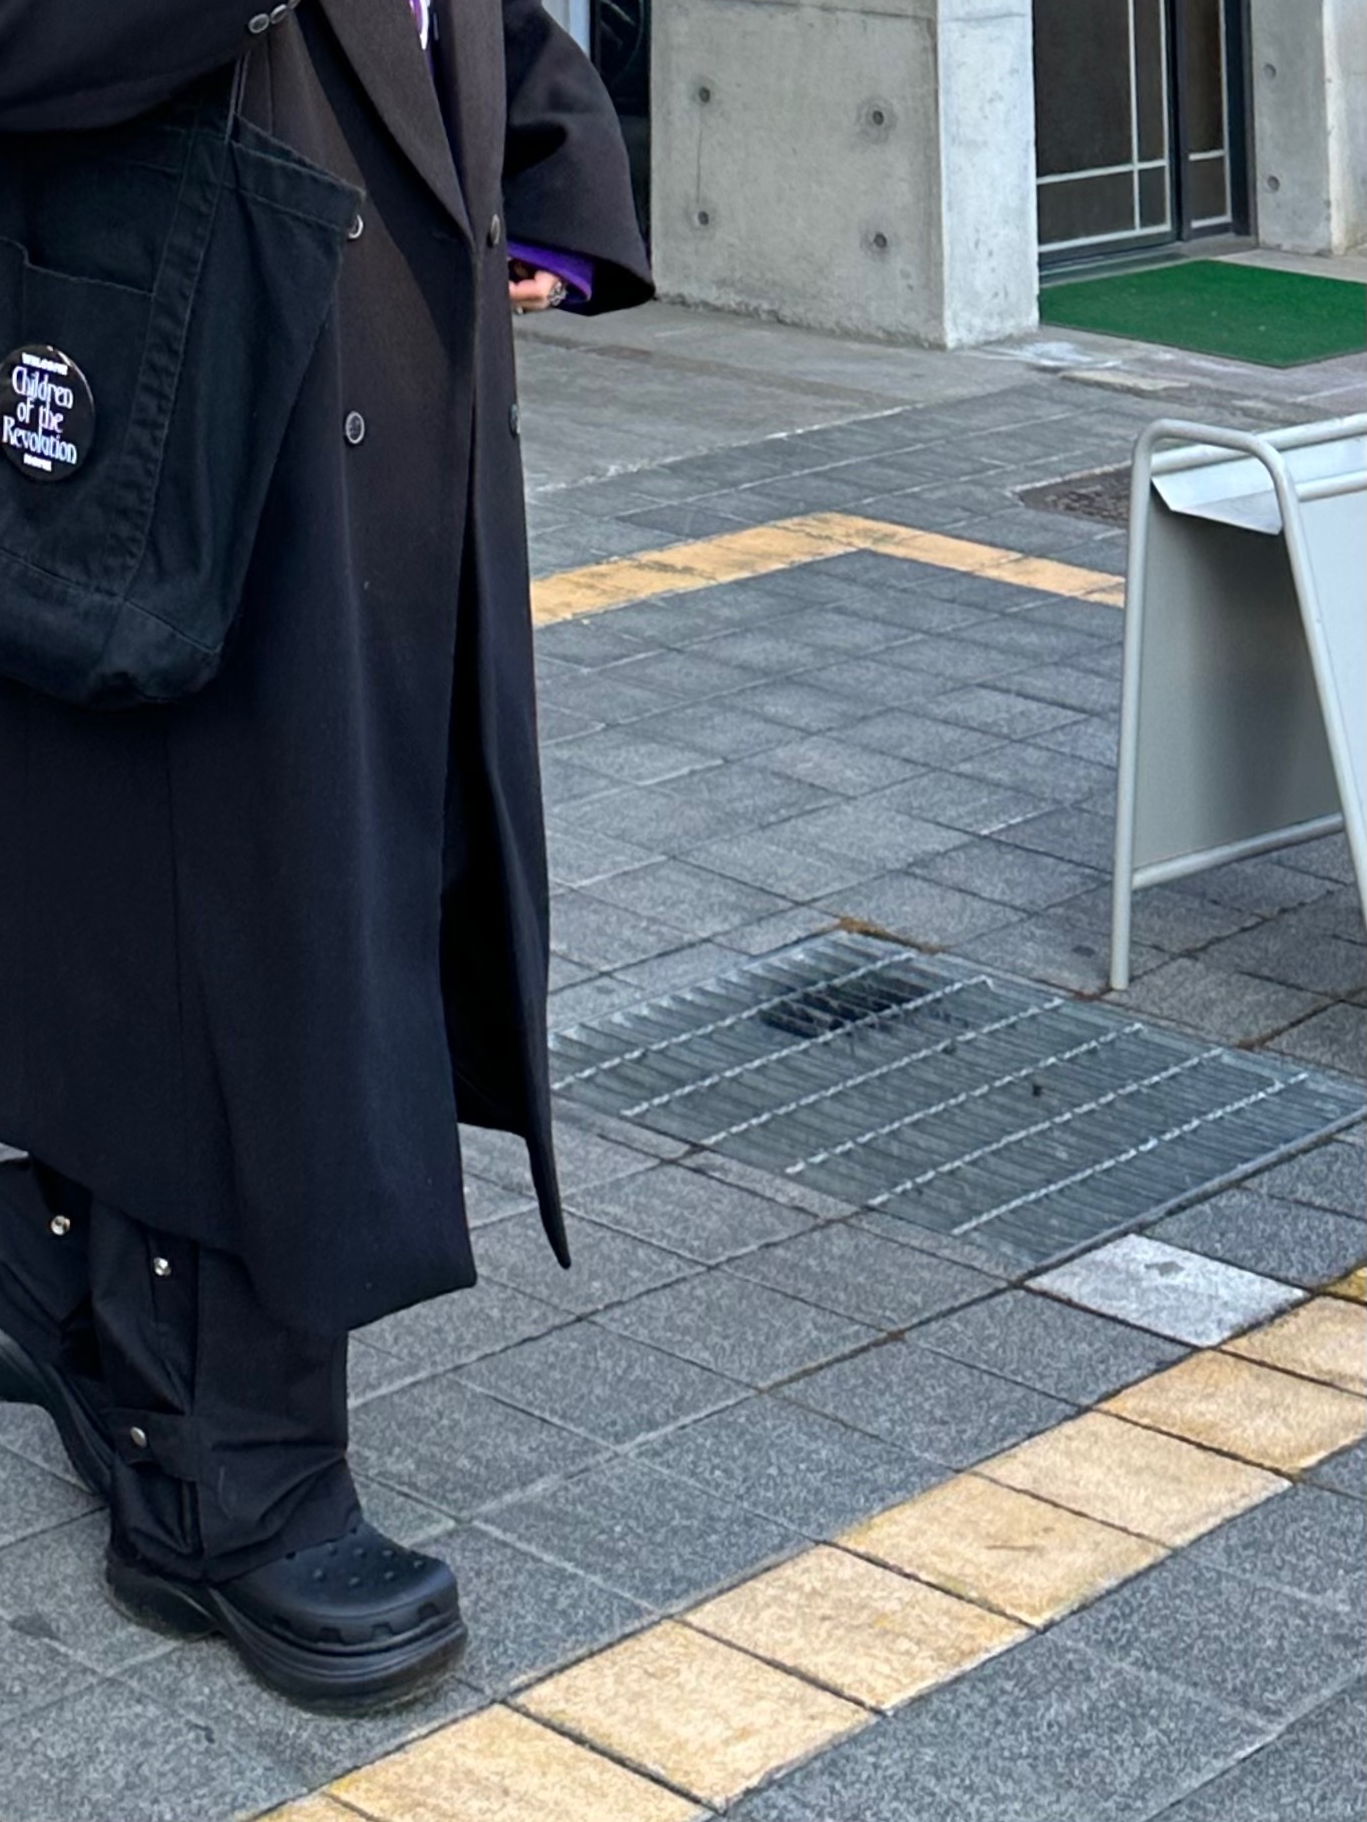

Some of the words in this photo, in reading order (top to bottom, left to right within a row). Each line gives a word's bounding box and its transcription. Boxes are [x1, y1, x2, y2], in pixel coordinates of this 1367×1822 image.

[12, 366, 74, 409] Children
[16, 398, 35, 424] of
[38, 399, 64, 434] the
[2, 415, 77, 465] Revolution
